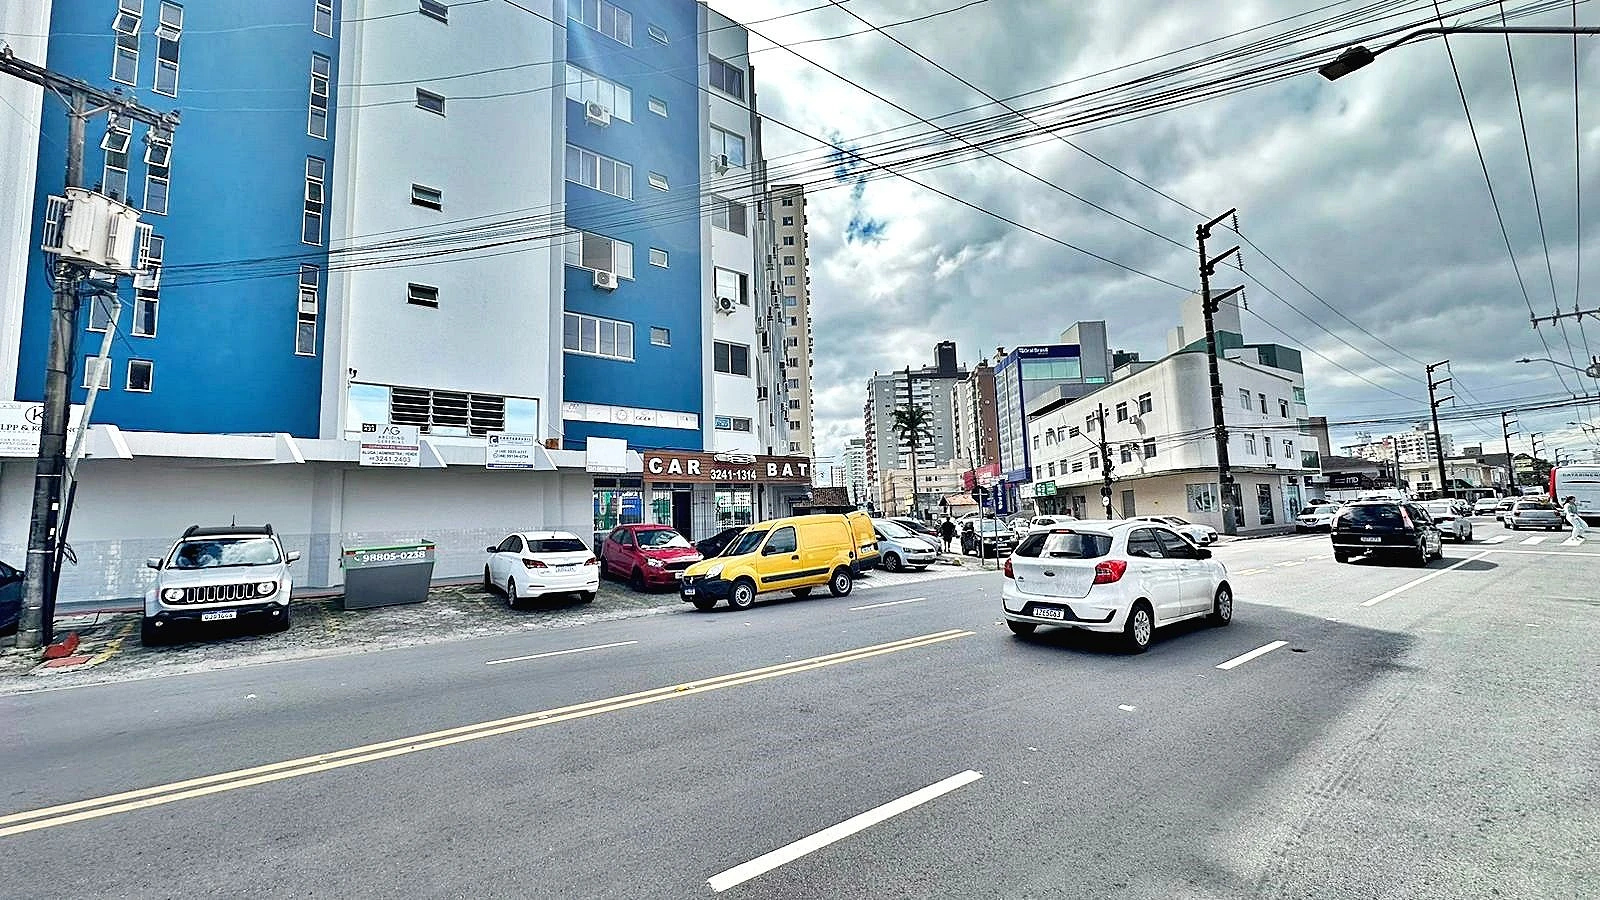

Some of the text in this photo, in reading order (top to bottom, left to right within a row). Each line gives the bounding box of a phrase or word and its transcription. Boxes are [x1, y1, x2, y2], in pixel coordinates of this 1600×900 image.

[648, 457, 808, 477] CAR BAT
[710, 469, 757, 481] 3241-1314
[362, 550, 426, 563] 98805-0238
